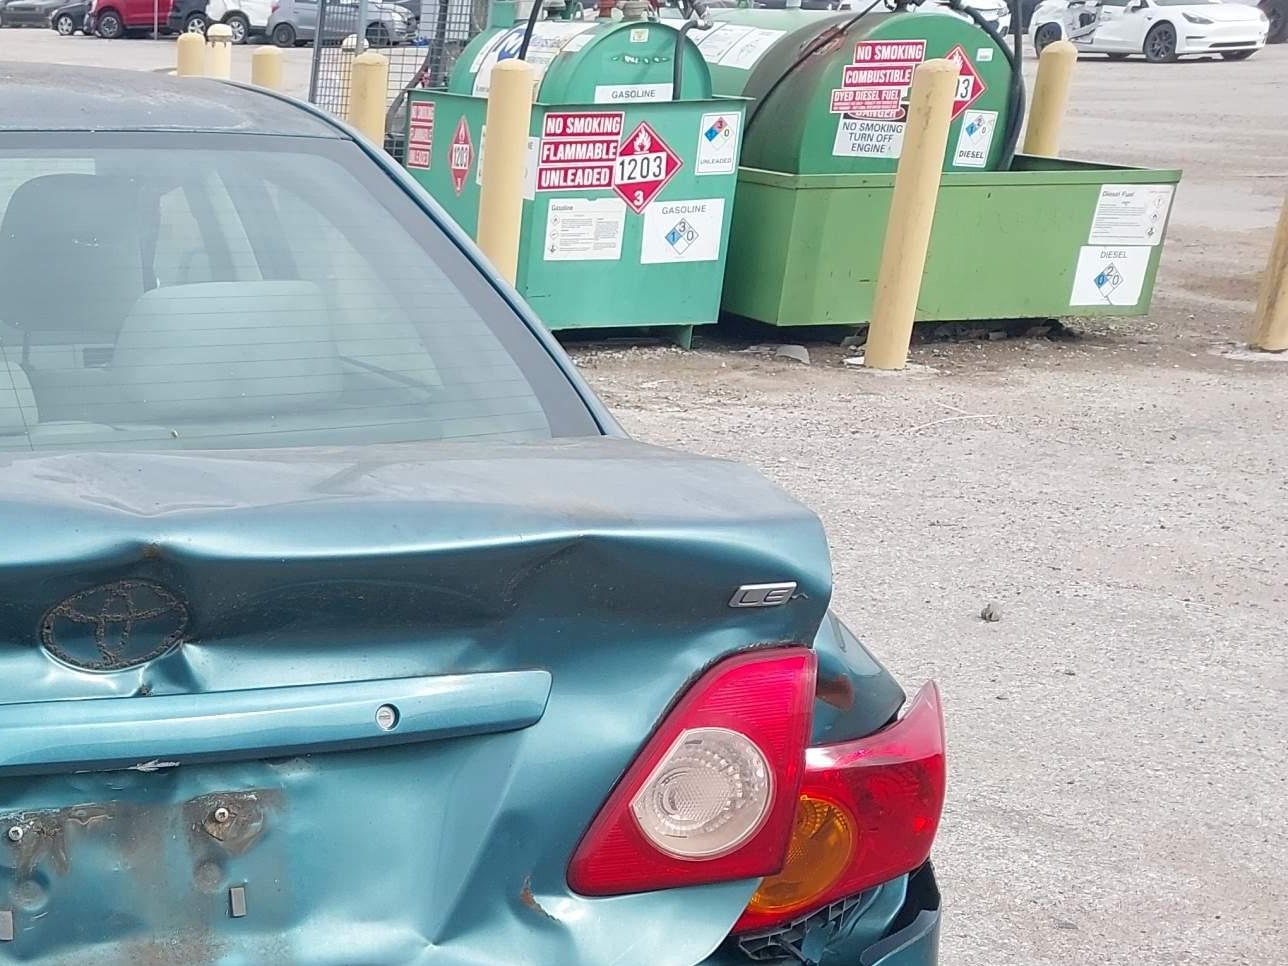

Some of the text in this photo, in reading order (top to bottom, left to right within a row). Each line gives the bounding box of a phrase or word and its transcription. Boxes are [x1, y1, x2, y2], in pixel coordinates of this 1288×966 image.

[857, 44, 923, 60] NO SMOKING
[845, 69, 912, 84] COMBUSTIBLE
[611, 90, 656, 99] GASOLINE
[834, 90, 899, 100] DYED DIESEL FUEL
[546, 116, 621, 133] NO SMOKING
[842, 121, 904, 133] NO SMOKING
[849, 132, 894, 143] TURN OFF
[542, 142, 617, 161] FLAMMABLE
[851, 143, 886, 153] ENGINE
[958, 150, 985, 159] DIESEL
[619, 155, 663, 182] 1203
[541, 167, 610, 187] UNLEADED
[633, 190, 644, 206] 3
[551, 204, 574, 212] Gasoline
[662, 205, 707, 215] GASOLINE
[678, 222, 686, 233] 3
[686, 230, 694, 241] 0
[1099, 250, 1128, 259] DIESEL
[1106, 266, 1114, 276] 2
[1112, 275, 1120, 286] 0
